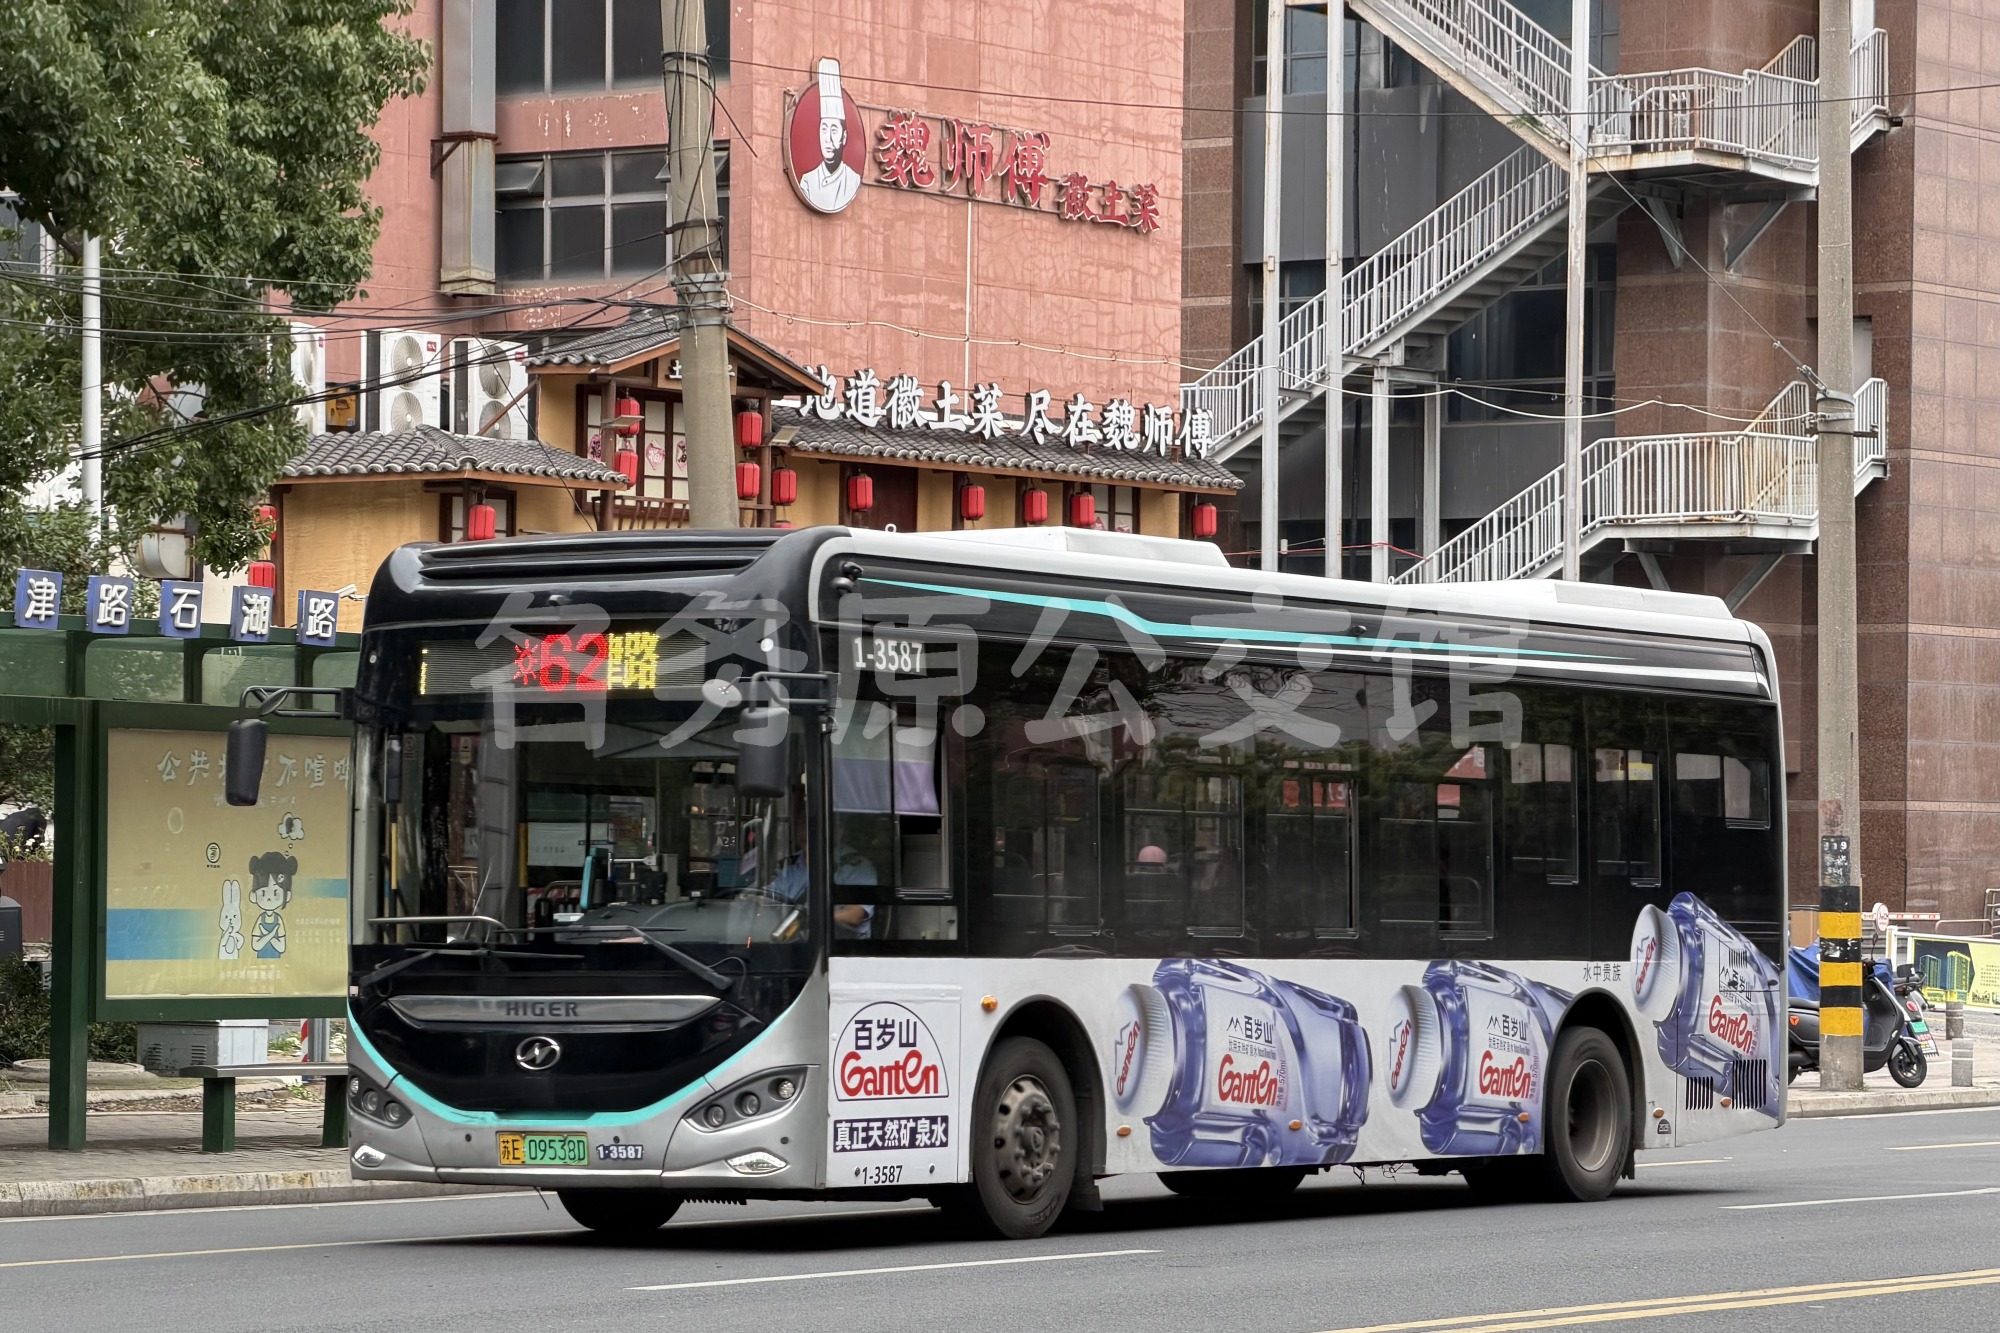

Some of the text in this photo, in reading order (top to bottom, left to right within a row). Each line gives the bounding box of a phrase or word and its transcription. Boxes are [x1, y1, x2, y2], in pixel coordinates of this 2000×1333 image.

[879, 111, 1051, 208] 魏师傅
[1061, 172, 1160, 233] 徽土菜
[1021, 388, 1213, 460] 尽在魏师傅
[540, 633, 608, 693] 62
[854, 637, 922, 672] 1-3587
[1583, 963, 1622, 982] 水中贵族
[506, 1001, 579, 1017] HIGER
[854, 1018, 918, 1050] 百岁山
[1244, 1015, 1273, 1044] 百岁山
[1502, 1014, 1527, 1041] 百岁山
[1218, 1053, 1278, 1106] Ganten
[1479, 1050, 1531, 1098] Ganten
[836, 1117, 948, 1151] 真正天然矿泉水
[862, 1165, 903, 1185] 1-3587
